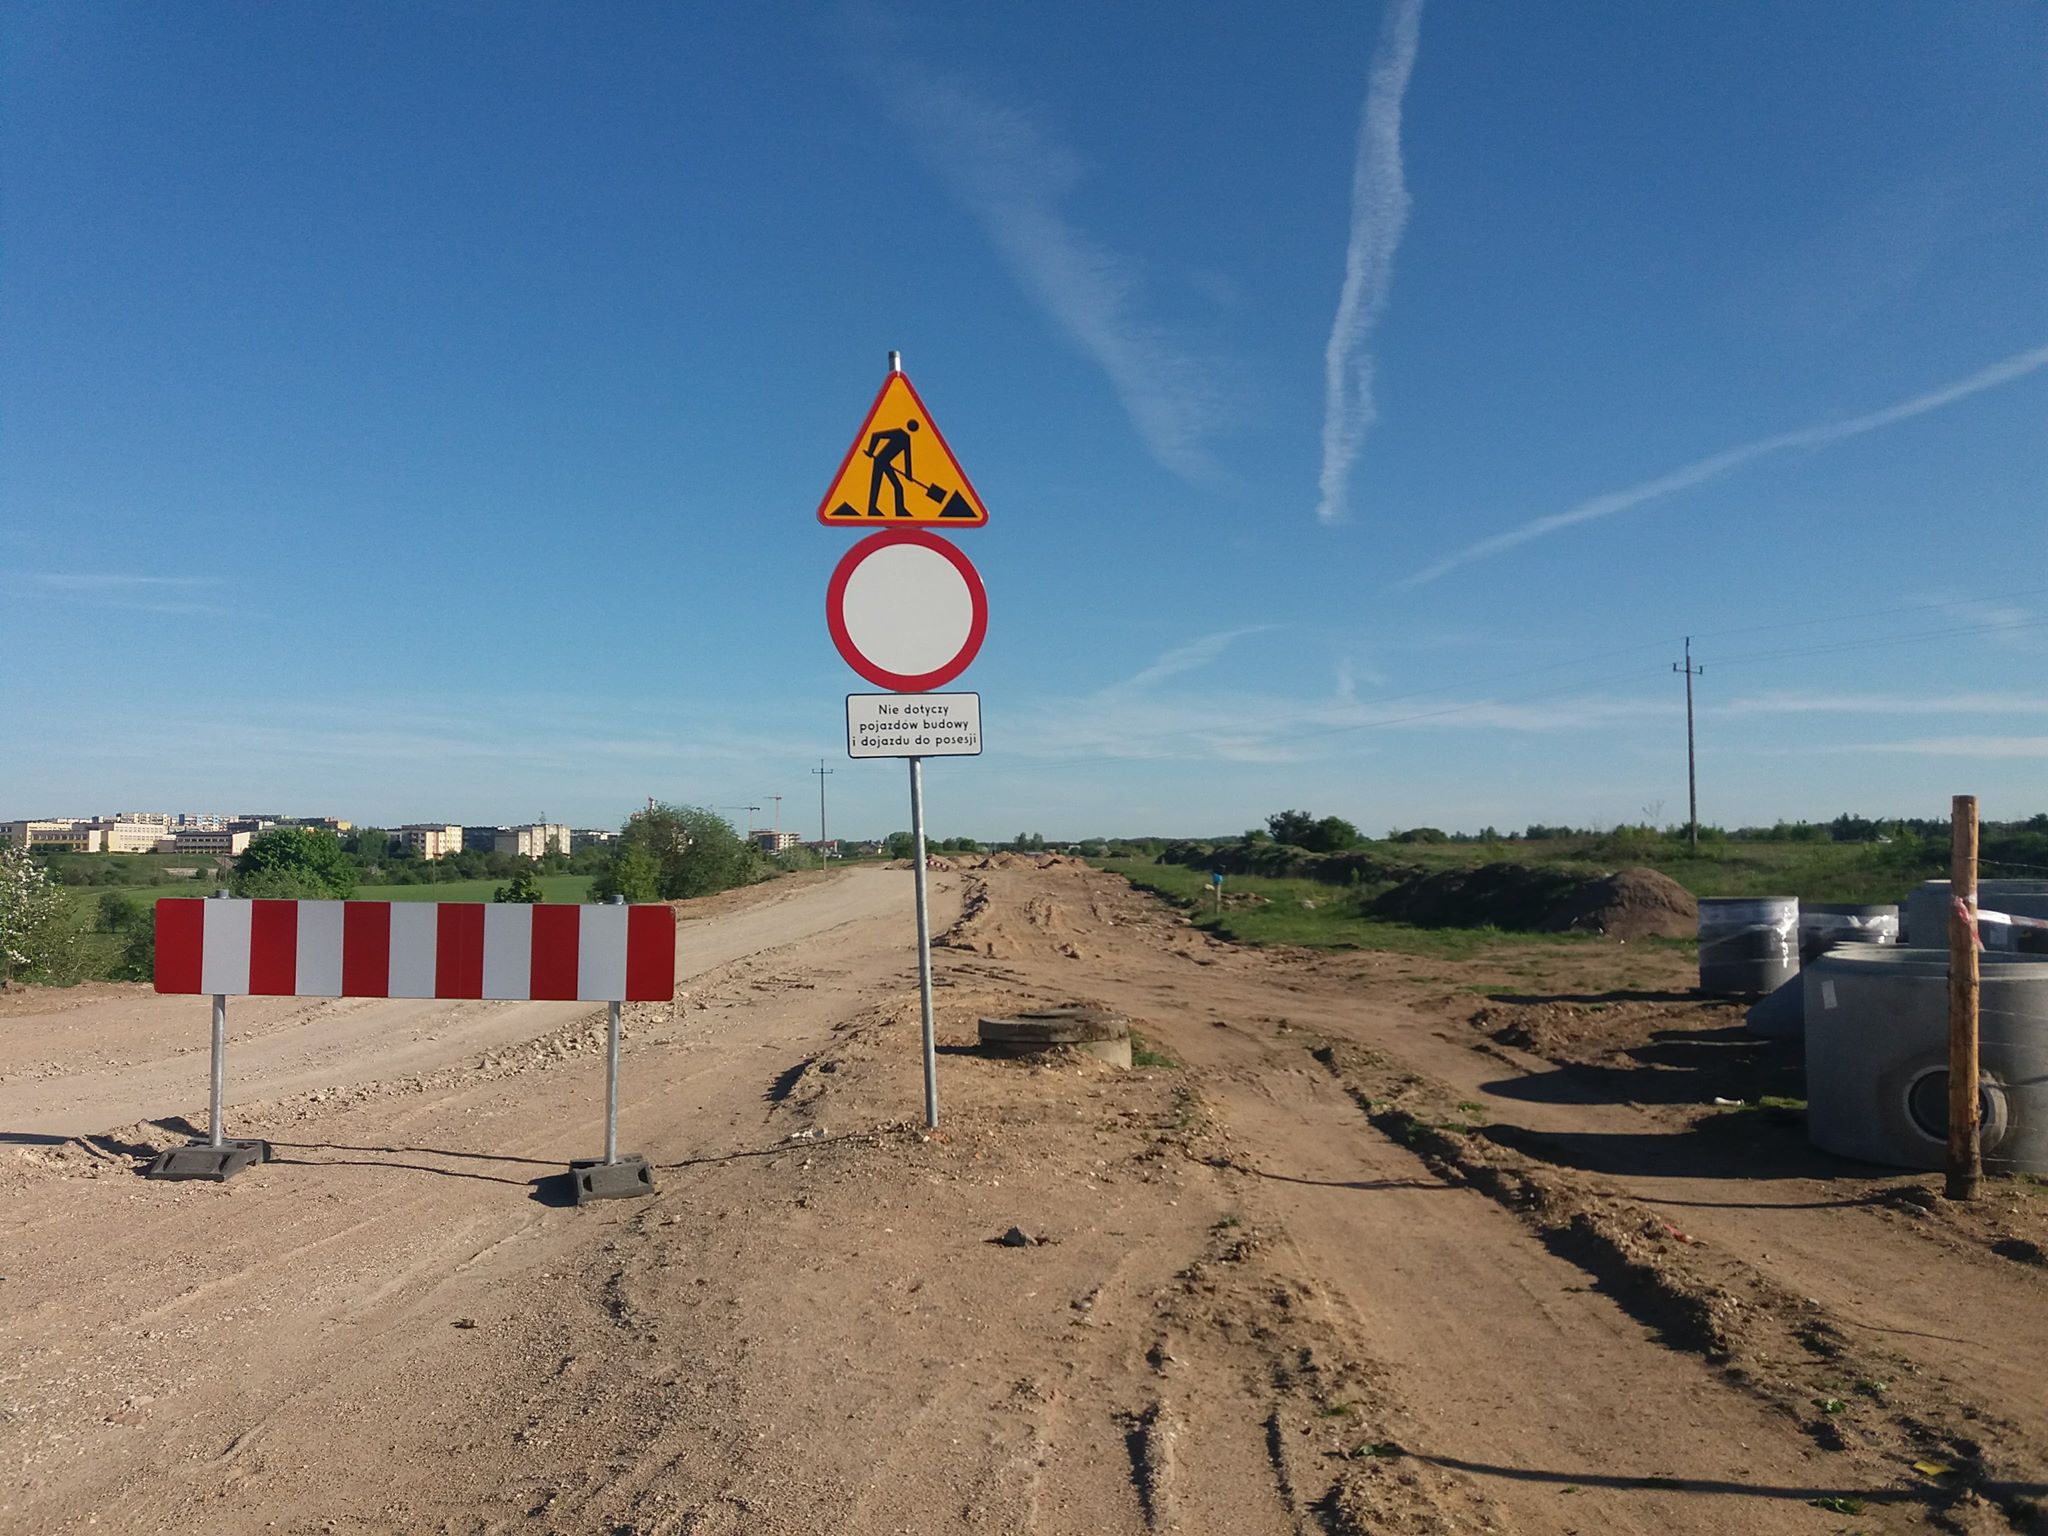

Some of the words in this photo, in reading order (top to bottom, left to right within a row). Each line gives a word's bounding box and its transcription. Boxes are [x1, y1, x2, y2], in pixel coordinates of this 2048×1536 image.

[878, 704, 899, 715] Nie
[903, 704, 949, 717] dotyczy
[859, 719, 919, 734] pojazdów
[922, 718, 969, 731] budowy
[860, 735, 910, 749] dojazdu
[914, 734, 931, 745] do
[935, 732, 977, 747] posesji
